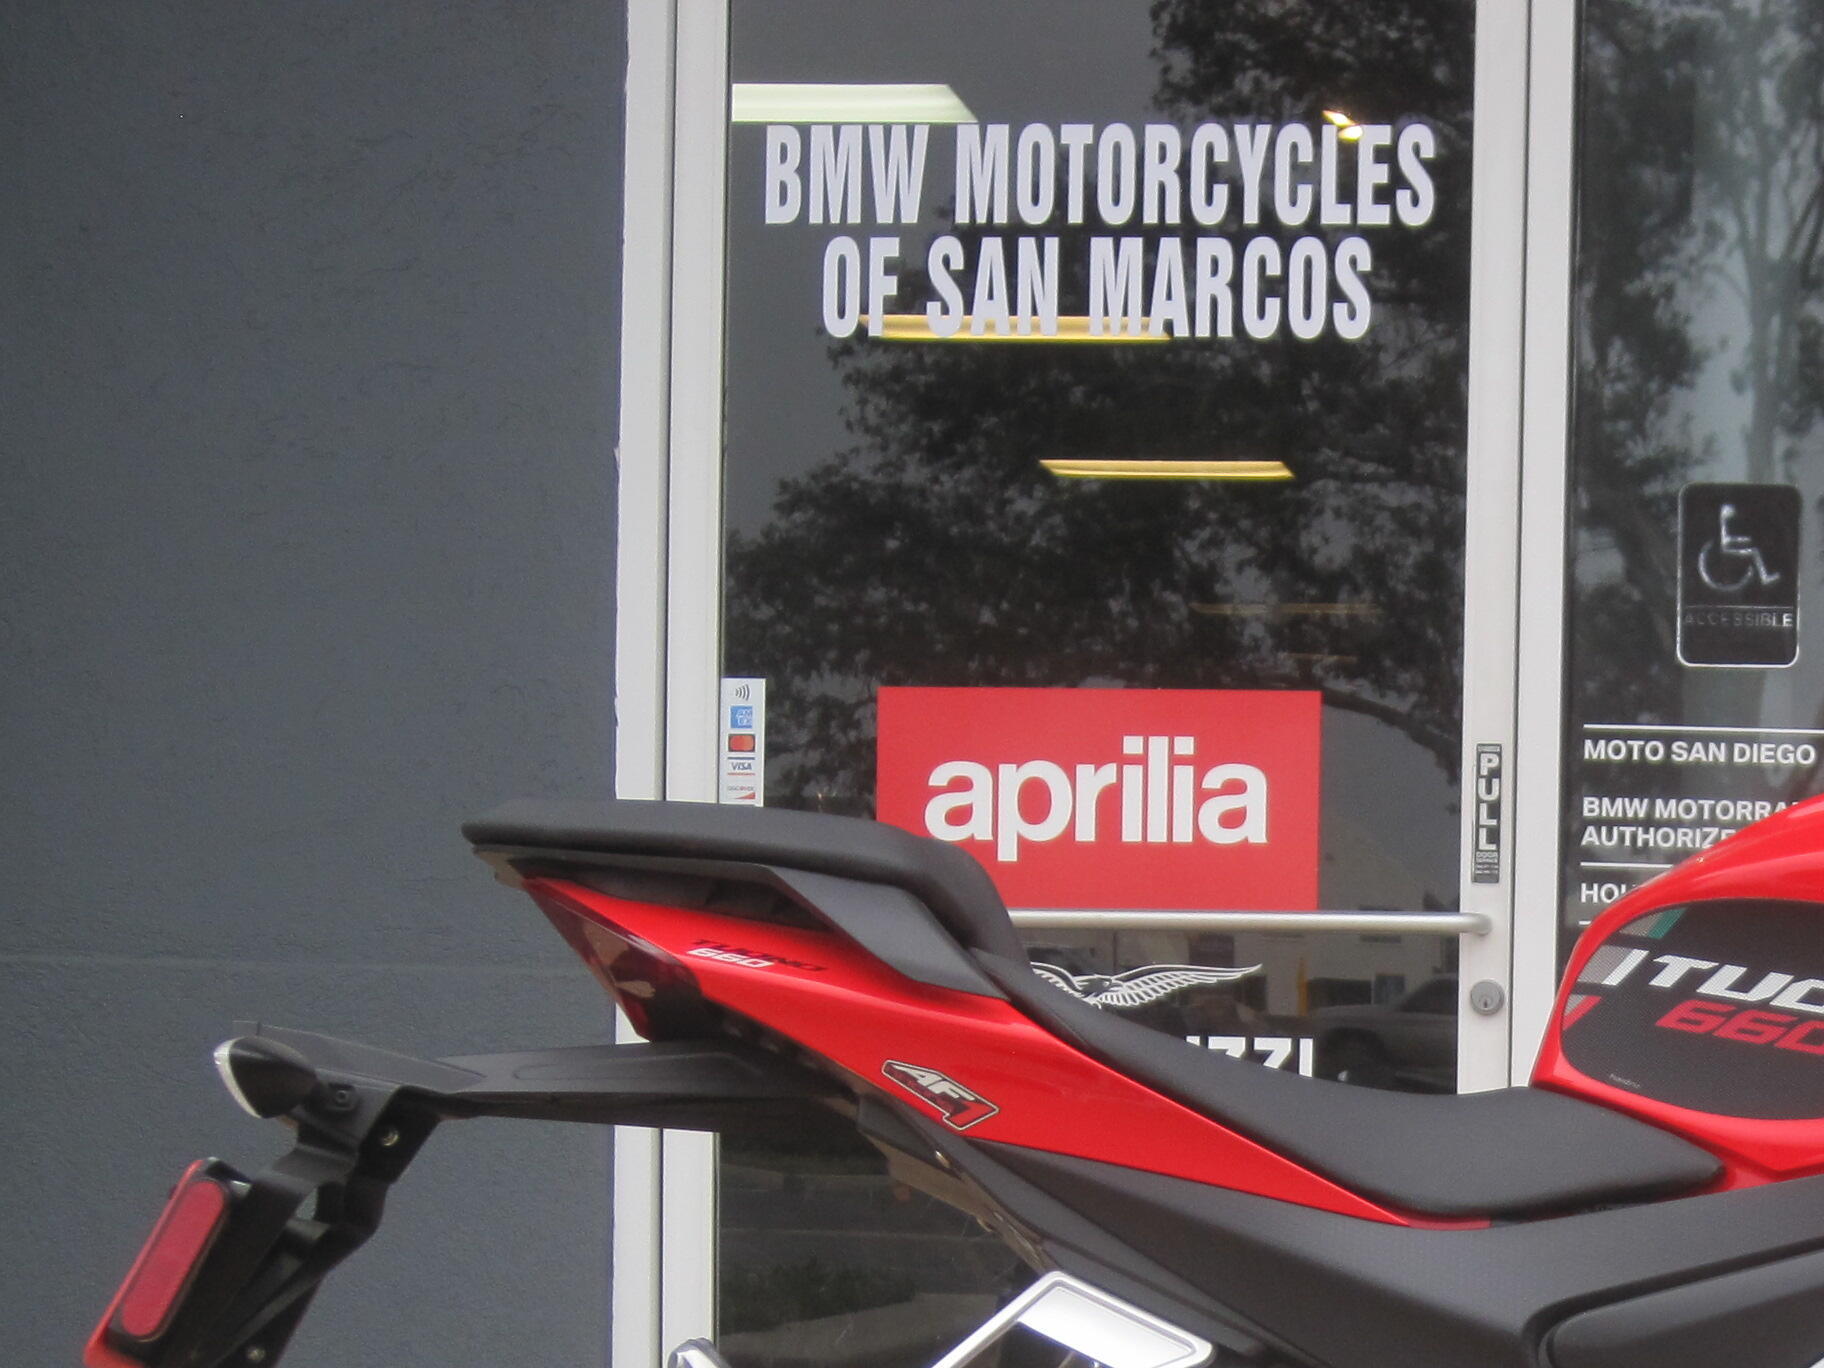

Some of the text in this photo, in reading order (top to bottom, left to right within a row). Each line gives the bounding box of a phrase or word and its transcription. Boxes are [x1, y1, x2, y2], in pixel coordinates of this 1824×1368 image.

[764, 122, 1436, 227] BMW MOTORCYCLES
[822, 236, 1373, 339] OF SAN MARCOS
[731, 762, 753, 771] VISA
[1584, 739, 1816, 765] MOTO SAN DIEGO
[924, 736, 1268, 862] aprilia
[1478, 752, 1499, 851] PULL
[1582, 797, 1799, 821] BMW MOTORRA
[683, 946, 776, 969] 660
